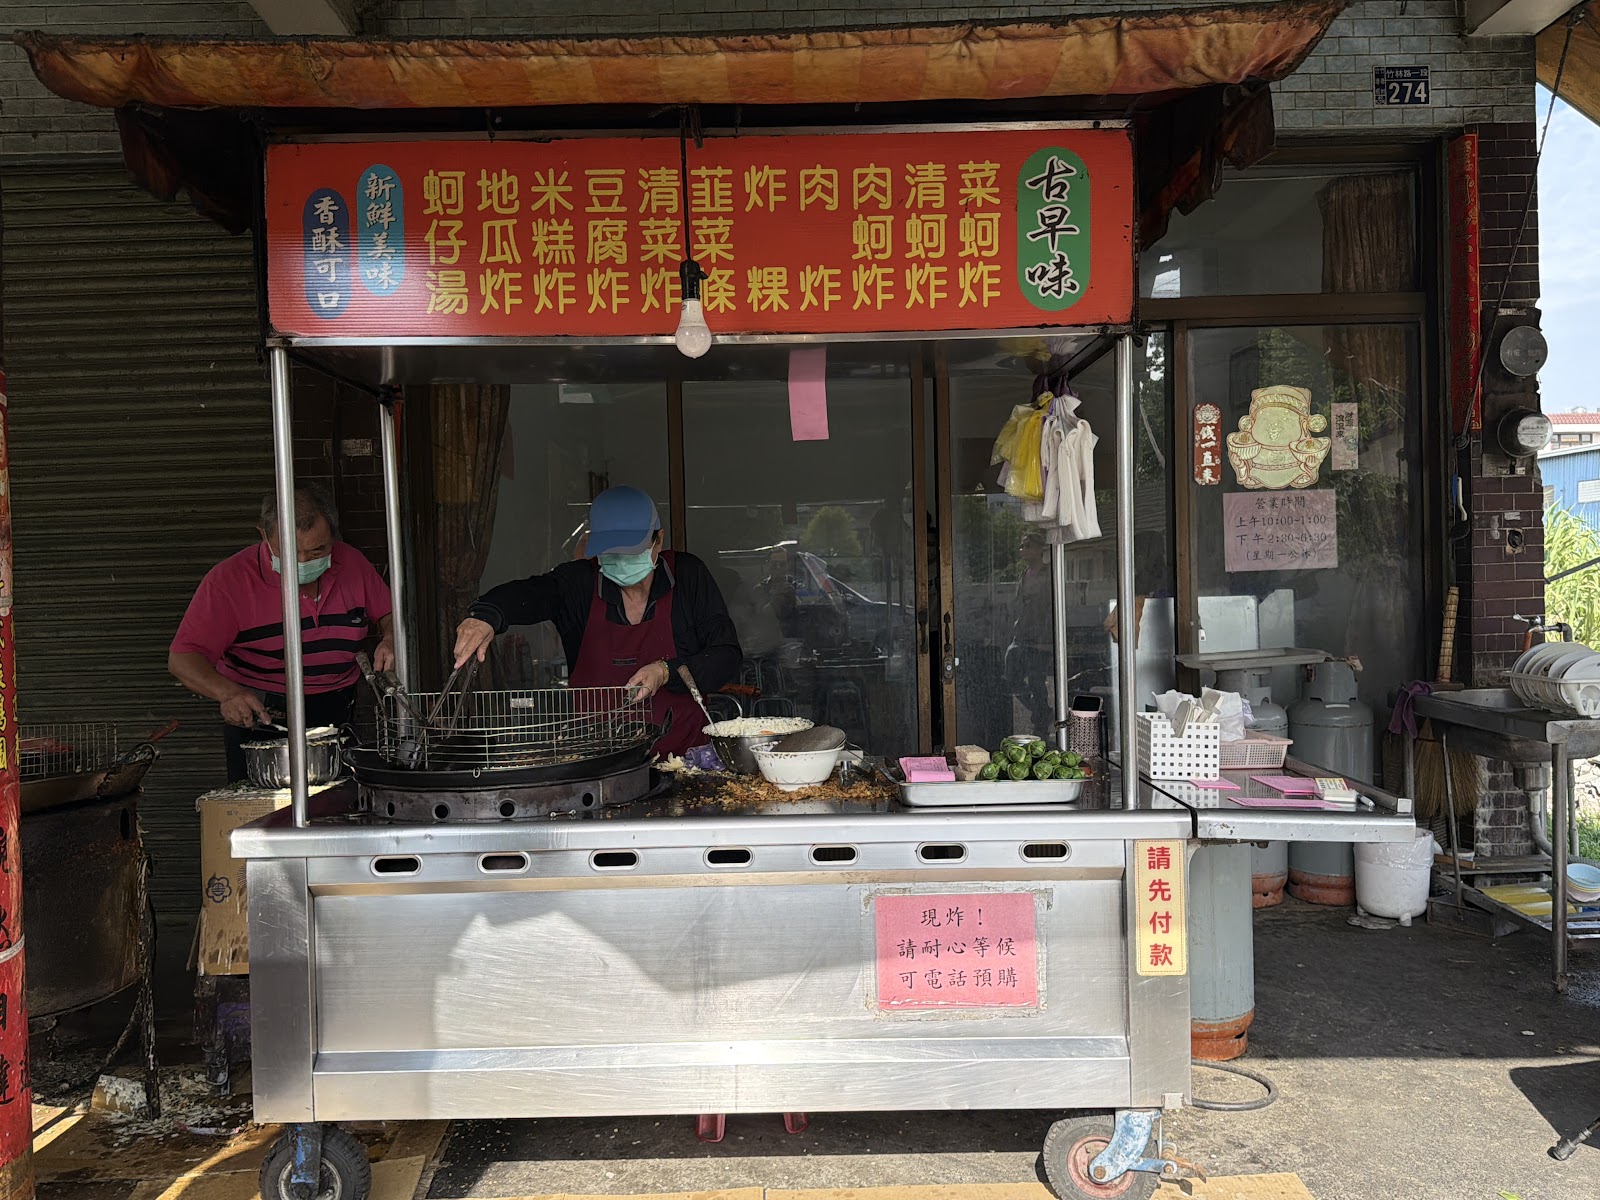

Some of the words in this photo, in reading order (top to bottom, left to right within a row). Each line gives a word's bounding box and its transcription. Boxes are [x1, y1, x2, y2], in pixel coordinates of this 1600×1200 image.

[1386, 69, 1428, 78] 竹林路一段
[1389, 82, 1427, 103] 274
[312, 197, 345, 310] 香酥可口
[365, 173, 399, 290] 新鮮美味
[423, 169, 467, 314] 蚵仔湯
[477, 168, 523, 314] 地瓜炸
[531, 168, 576, 314] 米糕炸
[585, 168, 630, 314] 豆腐炸
[638, 167, 682, 314] 清菜炸
[852, 162, 895, 310] 肉蚵炸
[905, 161, 948, 309] 清蚵炸
[958, 160, 1002, 308] 菜蚵炸
[1025, 155, 1080, 299] 古早味
[1255, 496, 1306, 510] 營業時間
[897, 936, 1017, 958] 請耐心等候
[1147, 846, 1173, 967] 請先付款
[899, 968, 1018, 990] 可電話預購
